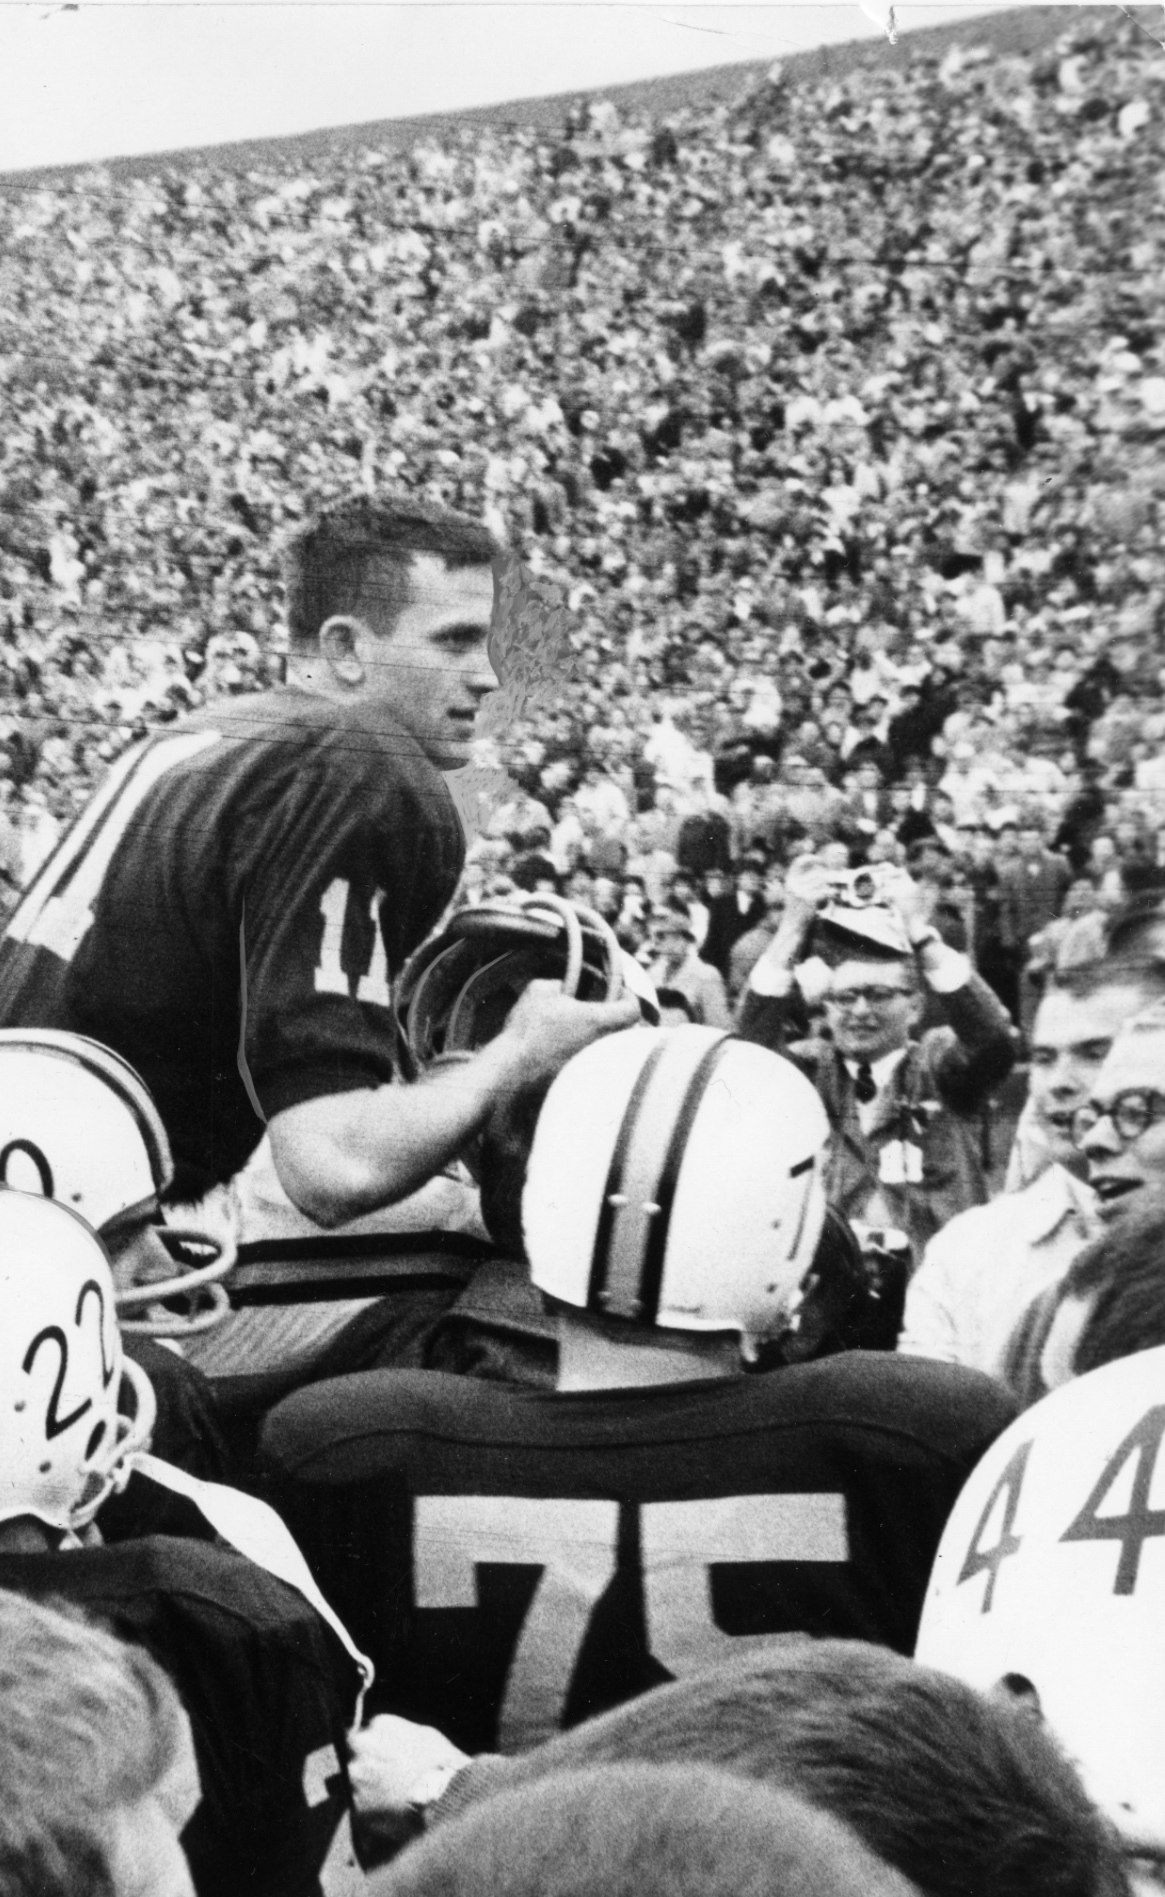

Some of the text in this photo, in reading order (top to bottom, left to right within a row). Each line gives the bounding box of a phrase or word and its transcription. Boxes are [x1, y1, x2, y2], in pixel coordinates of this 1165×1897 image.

[314, 878, 391, 1008] 11
[21, 1278, 115, 1442] 22
[955, 1403, 1165, 1615] 44
[413, 1492, 850, 1756] 75
